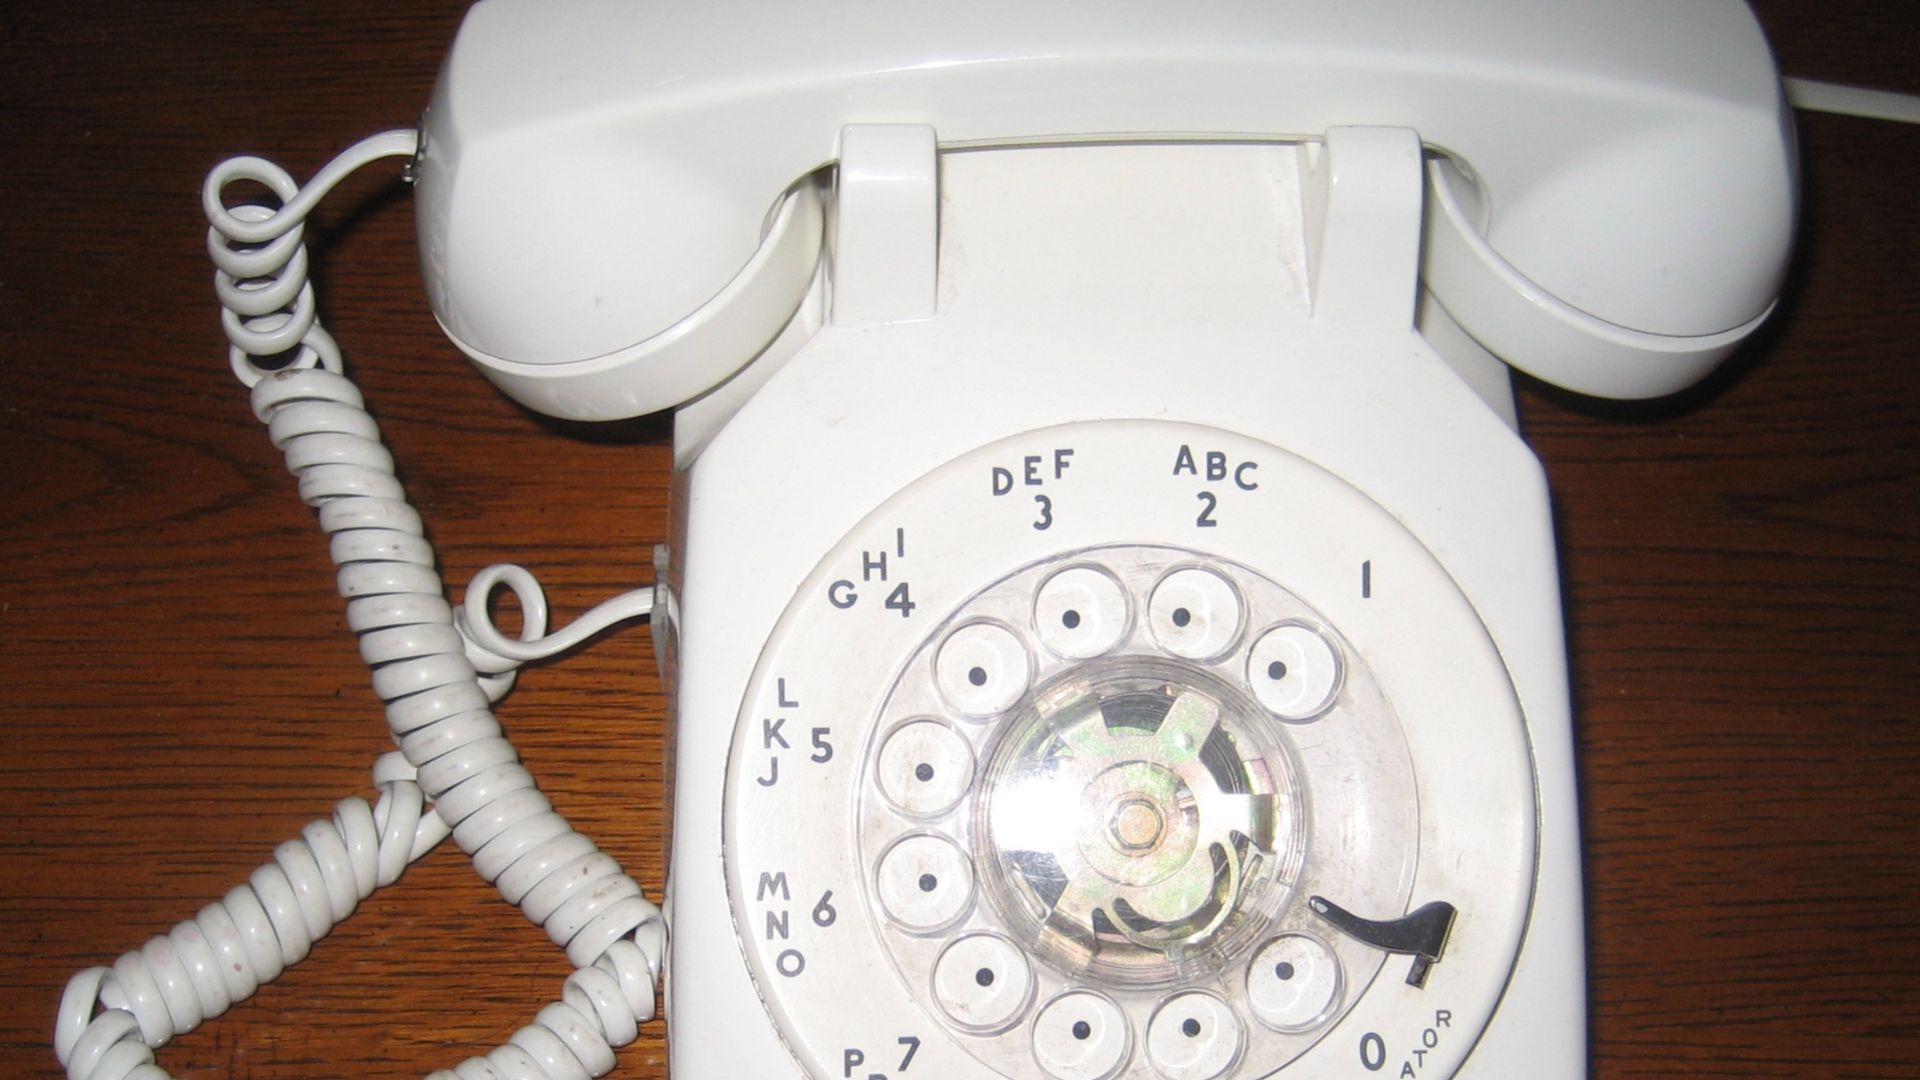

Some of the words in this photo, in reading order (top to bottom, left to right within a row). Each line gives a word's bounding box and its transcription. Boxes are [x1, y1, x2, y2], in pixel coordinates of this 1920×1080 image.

[1032, 494, 1053, 531] 3
[1195, 491, 1218, 528] 2
[884, 582, 916, 618] 4
[810, 727, 834, 764] 5
[811, 889, 837, 928] 6
[897, 1036, 921, 1072] 7
